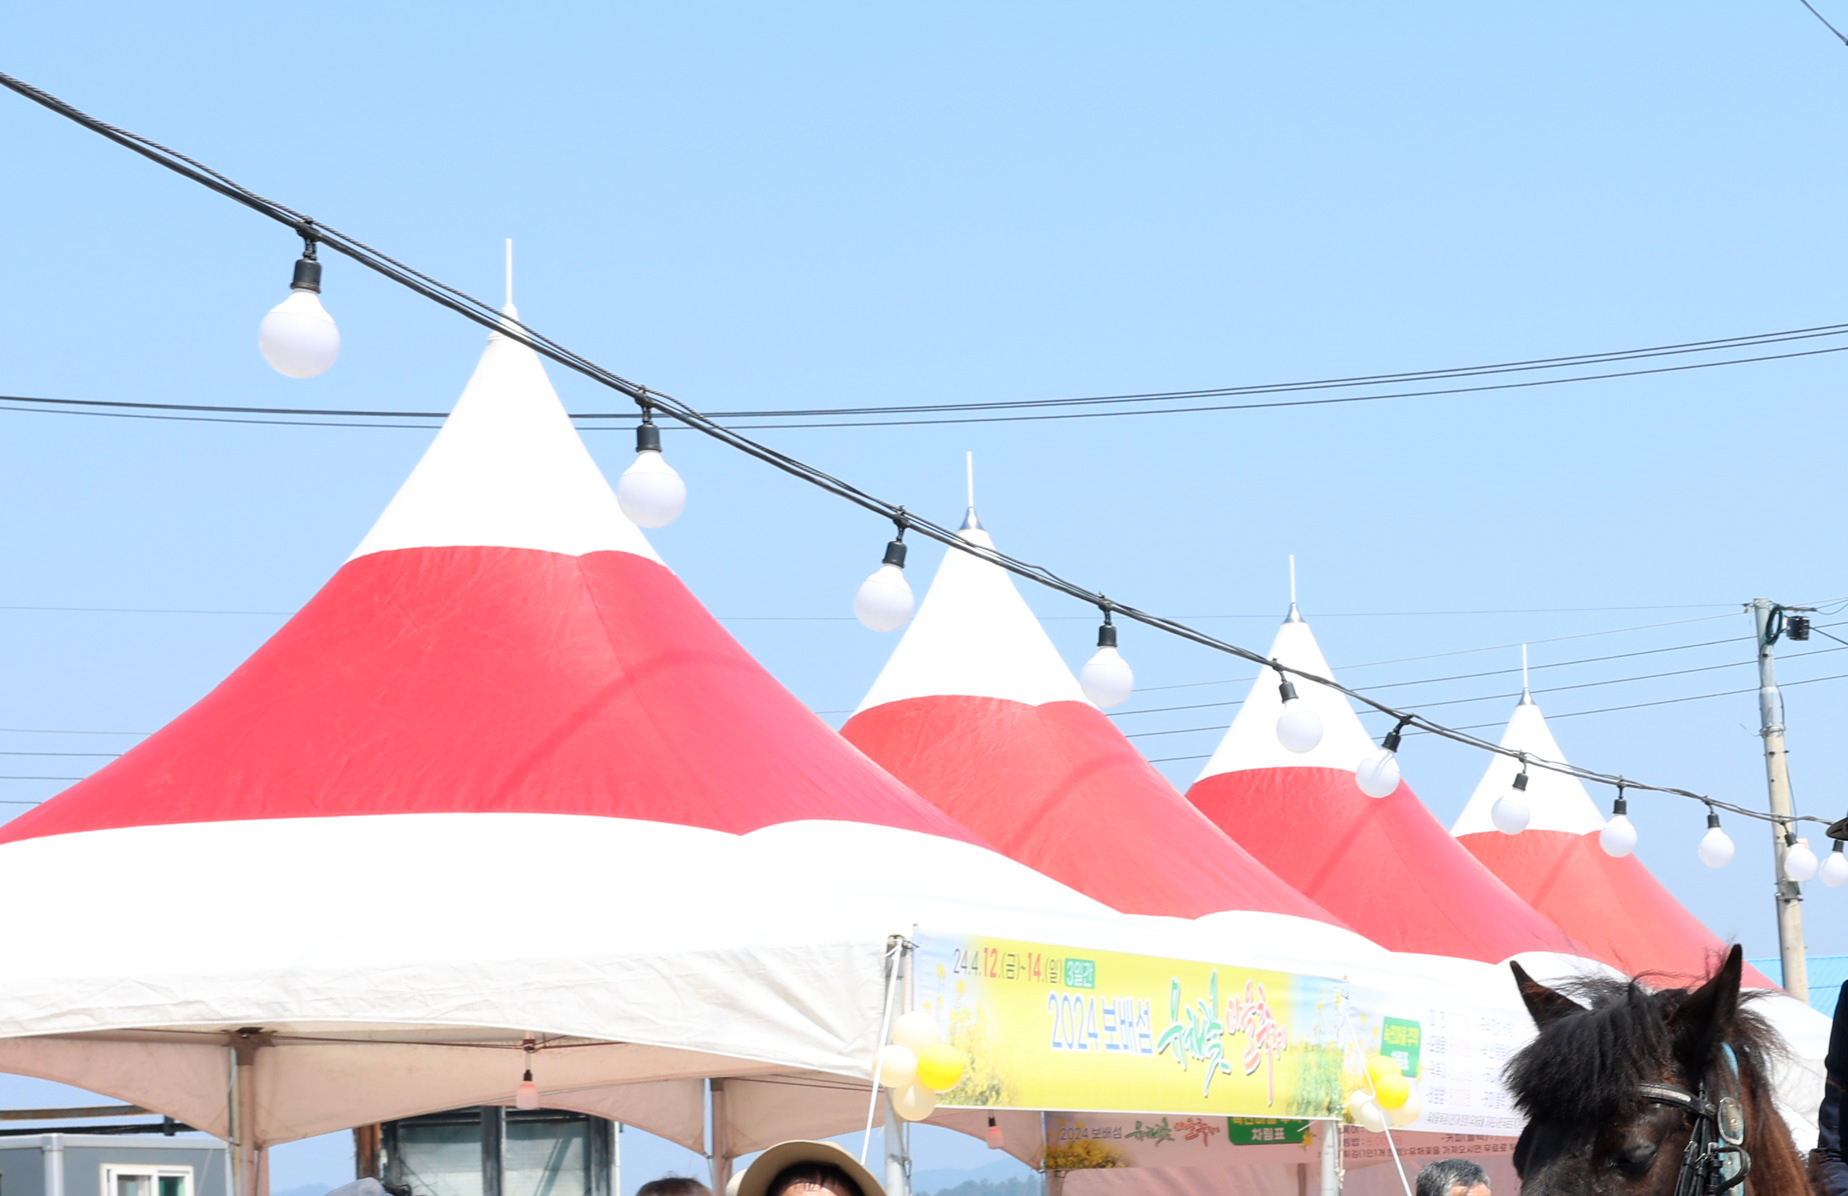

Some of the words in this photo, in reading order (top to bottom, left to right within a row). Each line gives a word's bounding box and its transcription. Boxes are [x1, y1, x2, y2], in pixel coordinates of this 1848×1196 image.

[1066, 959, 1095, 989] 3일간
[1048, 992, 1099, 1052] 2024
[1101, 996, 1154, 1056] 보배섬
[1060, 1126, 1089, 1141] 2024
[1091, 1125, 1122, 1141] 보배섬
[1251, 1126, 1286, 1142] 차림표
